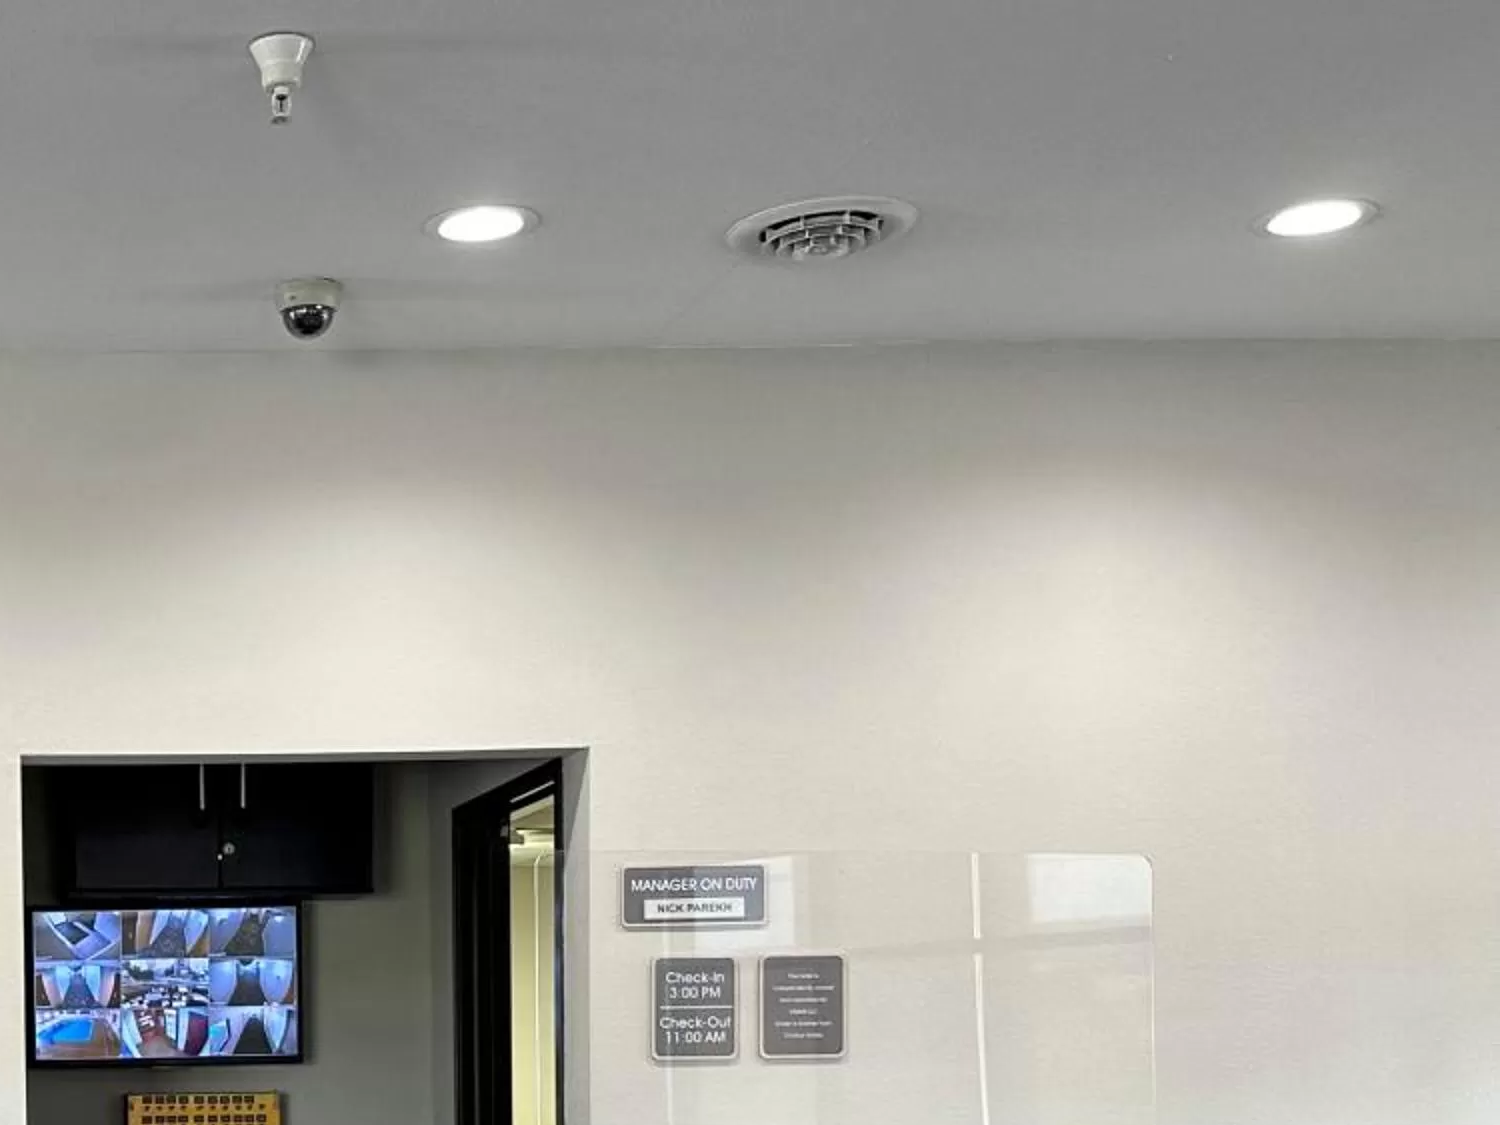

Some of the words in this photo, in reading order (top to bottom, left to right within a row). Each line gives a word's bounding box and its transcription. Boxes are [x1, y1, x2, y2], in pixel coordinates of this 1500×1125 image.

[631, 878, 697, 893] MANAGER
[700, 877, 722, 892] ON
[725, 875, 758, 891] DUTY
[657, 903, 684, 913] NICK
[665, 971, 725, 984] Check-In
[669, 986, 699, 999] 3:00
[702, 986, 722, 1000] PM
[660, 1015, 731, 1029] Check-Out
[666, 1031, 703, 1044] 11:00
[704, 1031, 727, 1043] AM
